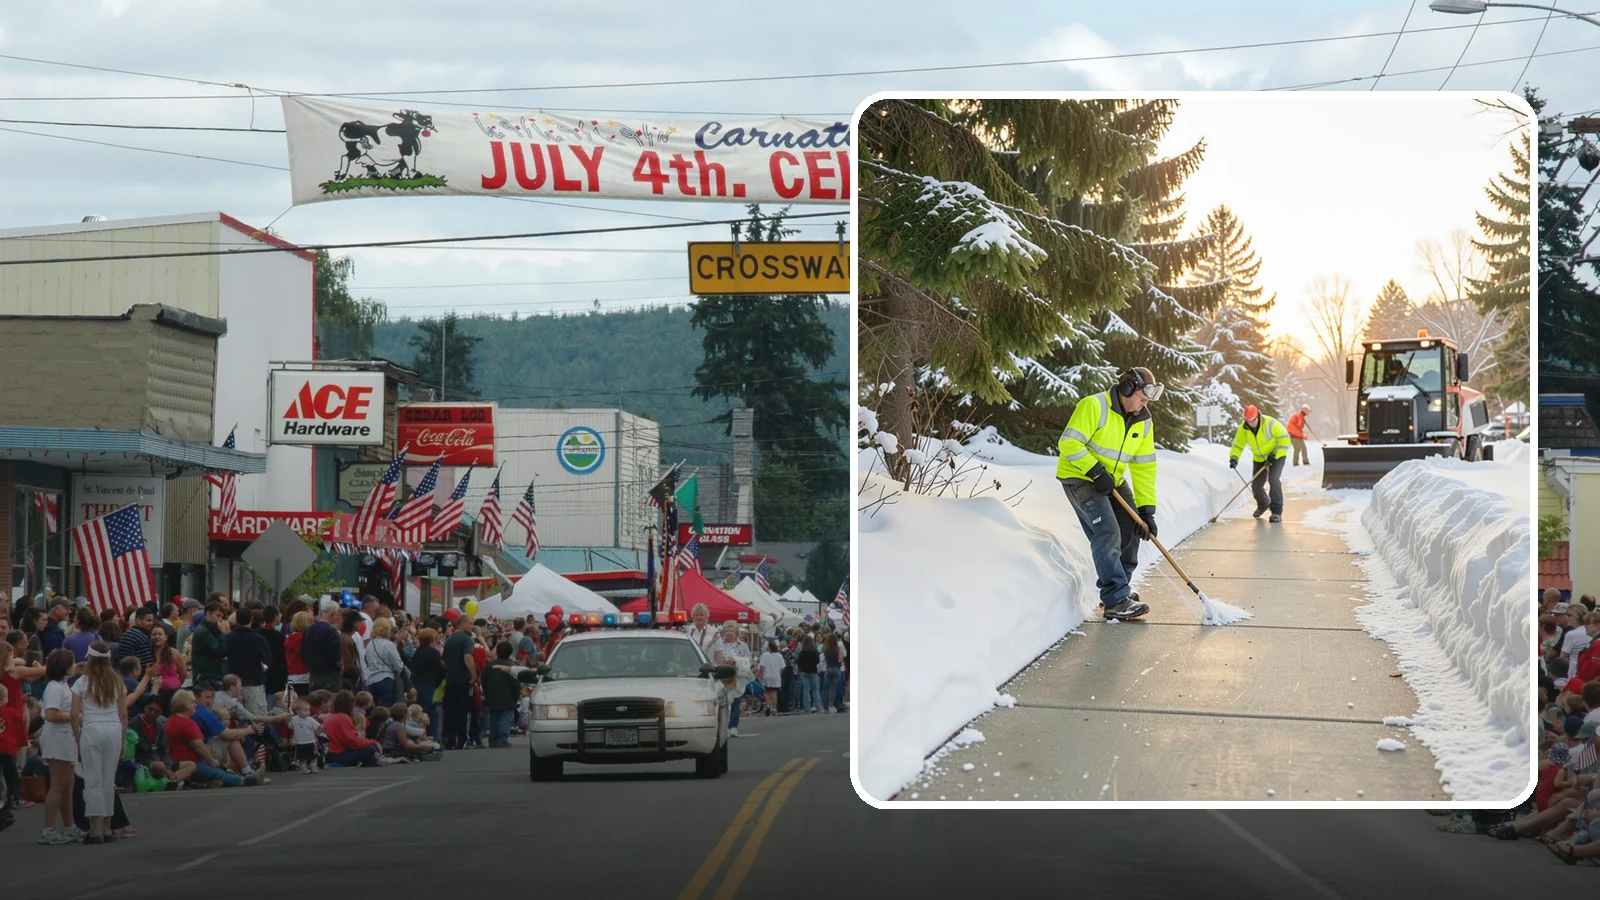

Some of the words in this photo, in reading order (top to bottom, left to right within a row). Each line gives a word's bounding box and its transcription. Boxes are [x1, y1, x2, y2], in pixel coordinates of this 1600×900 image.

[694, 121, 850, 150] Carnat
[481, 141, 605, 193] JULY
[632, 150, 746, 197] 4th.
[697, 254, 850, 280] CROSSWA
[282, 380, 374, 420] ACE
[405, 409, 452, 422] CEDAR
[461, 409, 485, 422] LOG
[283, 421, 371, 437] Hardware
[416, 428, 477, 447] Coca-Cola
[353, 466, 387, 480] Simpl
[95, 485, 124, 495] Vincent
[126, 485, 136, 495] de
[137, 485, 155, 495] Paul
[81, 503, 154, 522] THT
[688, 526, 742, 535] CRNATION
[699, 534, 730, 543] GLASS
